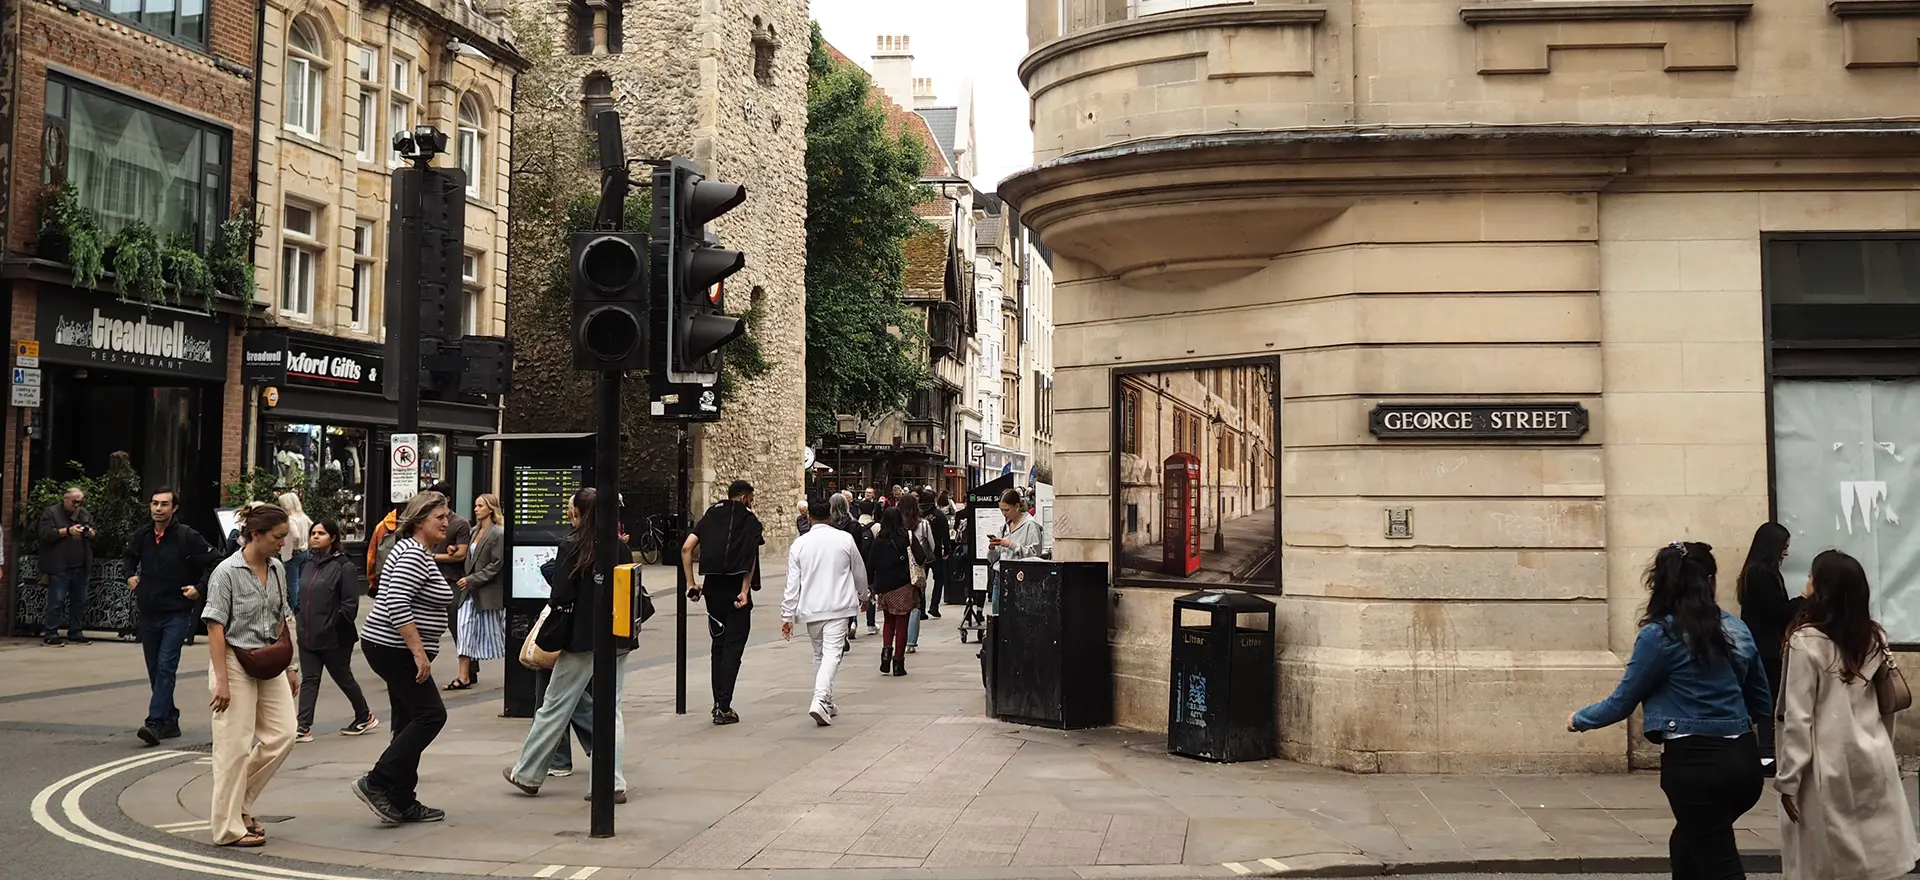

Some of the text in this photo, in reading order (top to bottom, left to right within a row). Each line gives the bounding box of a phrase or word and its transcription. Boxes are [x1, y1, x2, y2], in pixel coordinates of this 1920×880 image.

[92, 308, 184, 359] treadwell
[91, 351, 183, 370] RESTAURANT
[246, 351, 282, 362] treadwell
[330, 357, 361, 380] Gifts
[368, 367, 377, 382] &
[1384, 411, 1572, 430] GEORGE STREET
[1184, 634, 1204, 645] Litter
[1241, 638, 1261, 647] Litter
